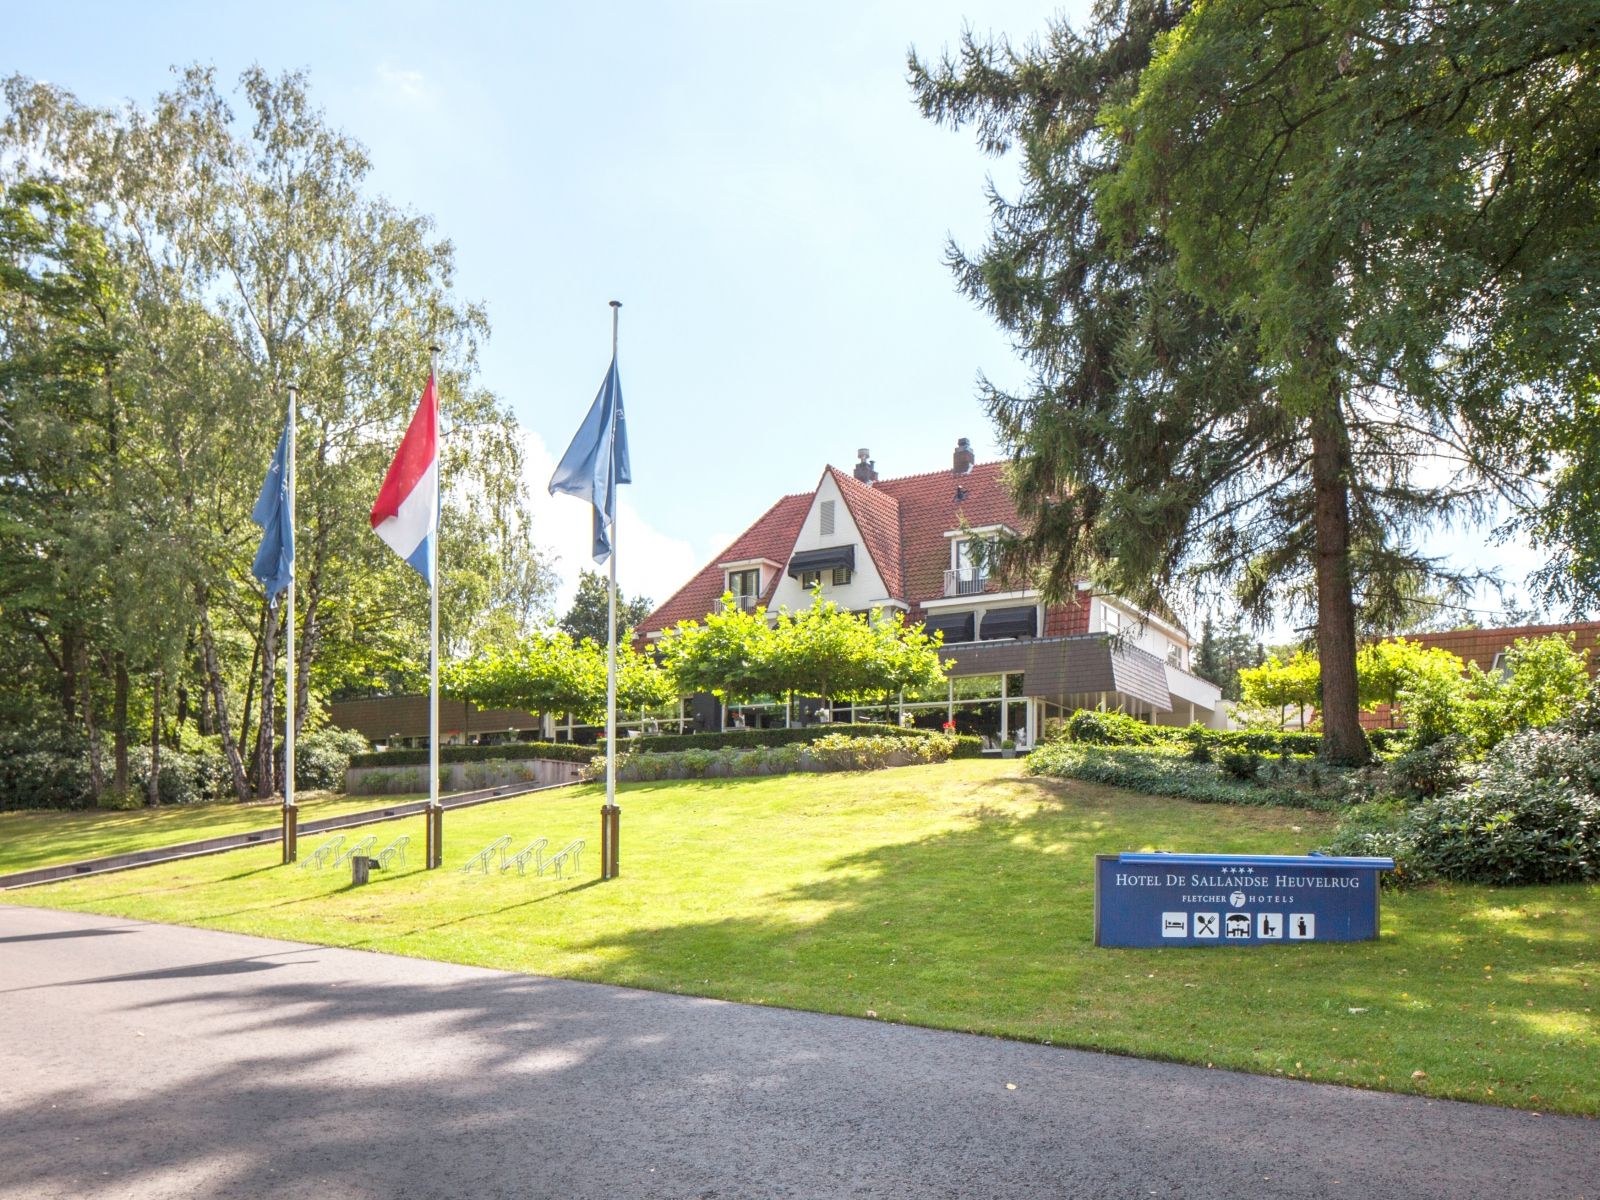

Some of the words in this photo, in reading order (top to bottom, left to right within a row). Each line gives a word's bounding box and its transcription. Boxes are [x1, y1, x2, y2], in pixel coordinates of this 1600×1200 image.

[1115, 873, 1162, 887] HOTEL
[1166, 874, 1187, 887] DE
[1191, 874, 1269, 888] SALLANDSE
[1275, 875, 1360, 888] HEUVELRUG
[1182, 895, 1227, 903] FLETCHER
[1249, 895, 1295, 903] HOTELS
